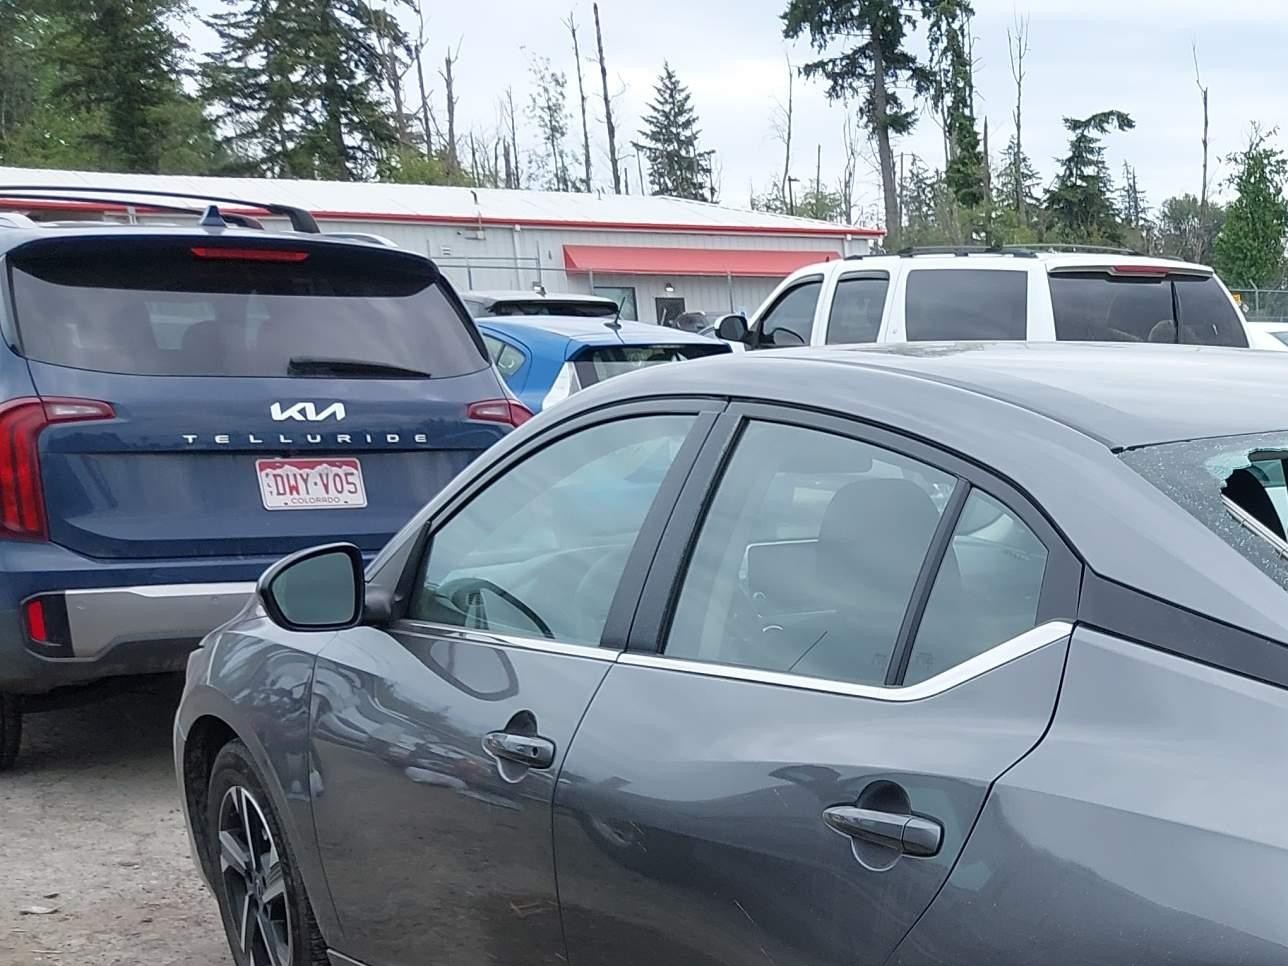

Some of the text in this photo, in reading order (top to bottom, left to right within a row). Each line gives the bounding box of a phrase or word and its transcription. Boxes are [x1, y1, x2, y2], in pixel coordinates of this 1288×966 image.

[270, 402, 346, 420] KIA
[182, 434, 428, 444] TELLURIDE
[290, 496, 341, 505] COLORADO
